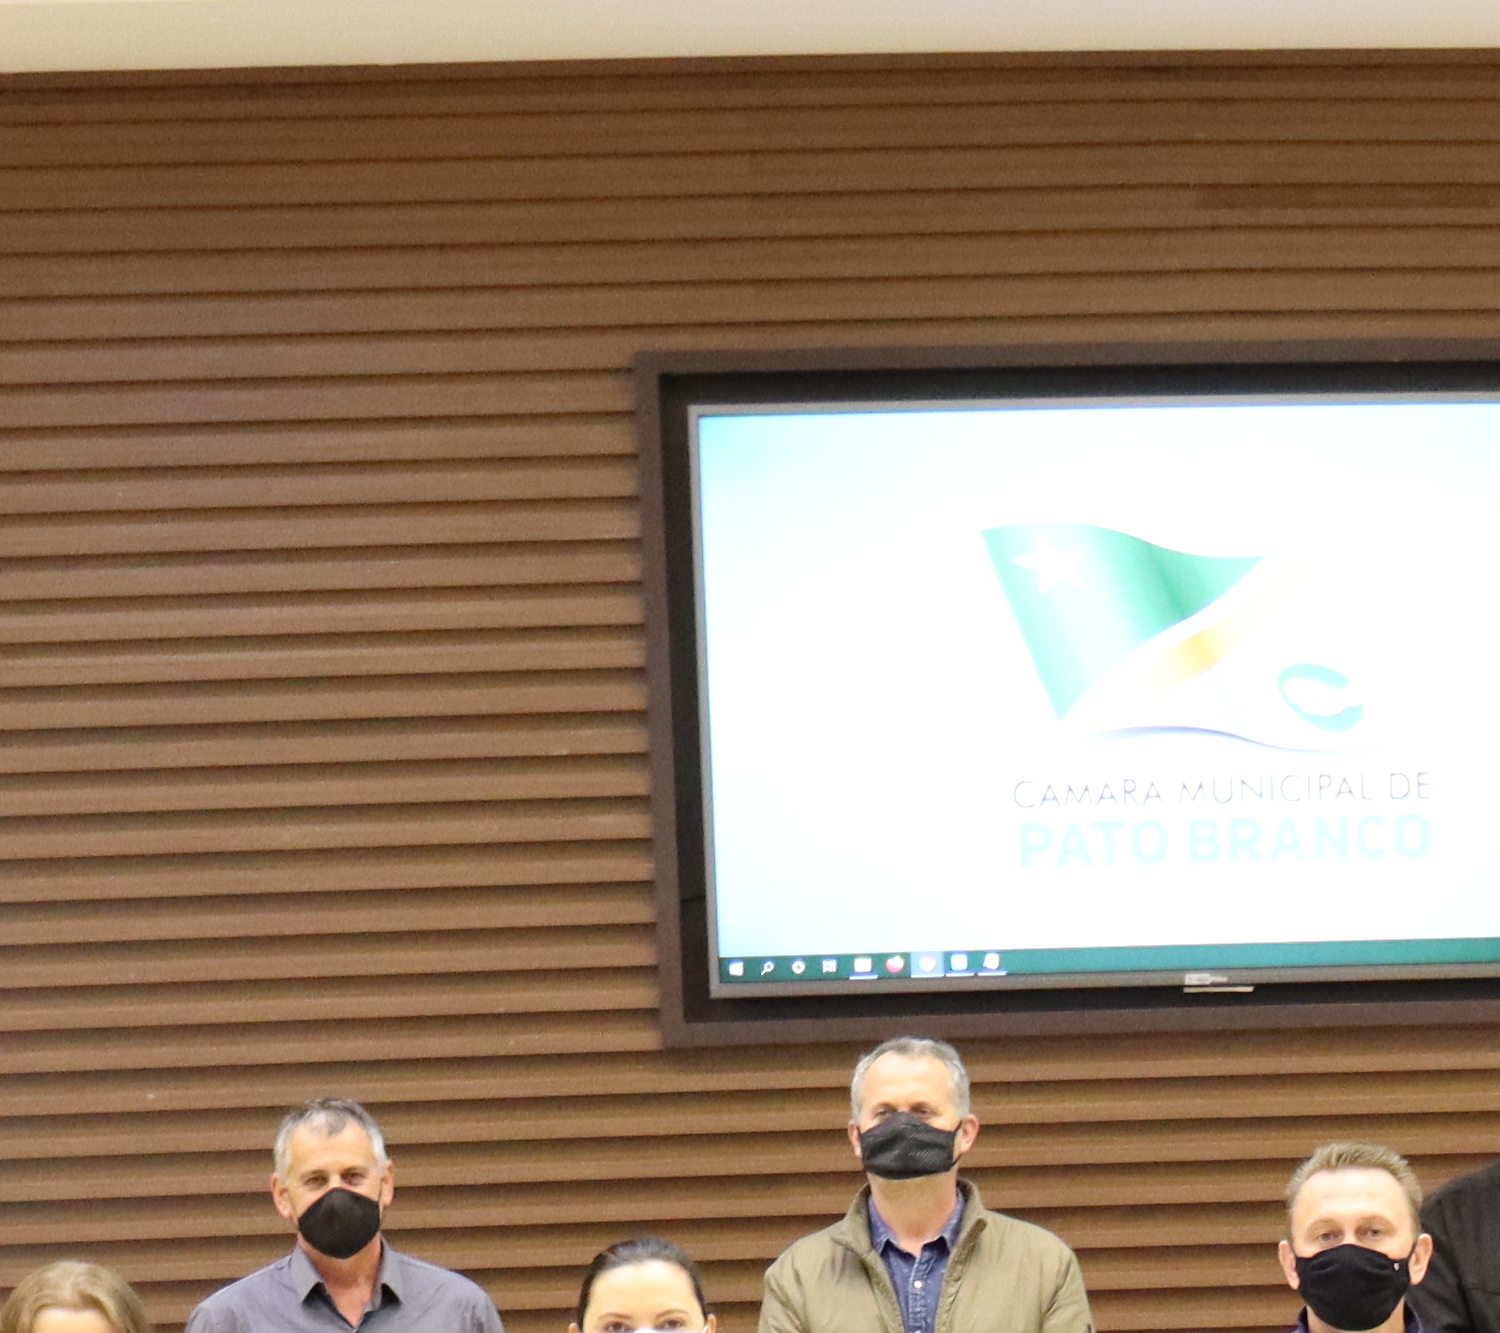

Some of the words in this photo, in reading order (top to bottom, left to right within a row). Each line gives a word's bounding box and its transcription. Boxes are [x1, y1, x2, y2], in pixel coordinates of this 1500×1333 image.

[1180, 774, 1373, 804] MUNICIPAL
[1389, 772, 1430, 800] DE
[1018, 819, 1168, 869] PATO
[1187, 813, 1431, 864] BRANCO
